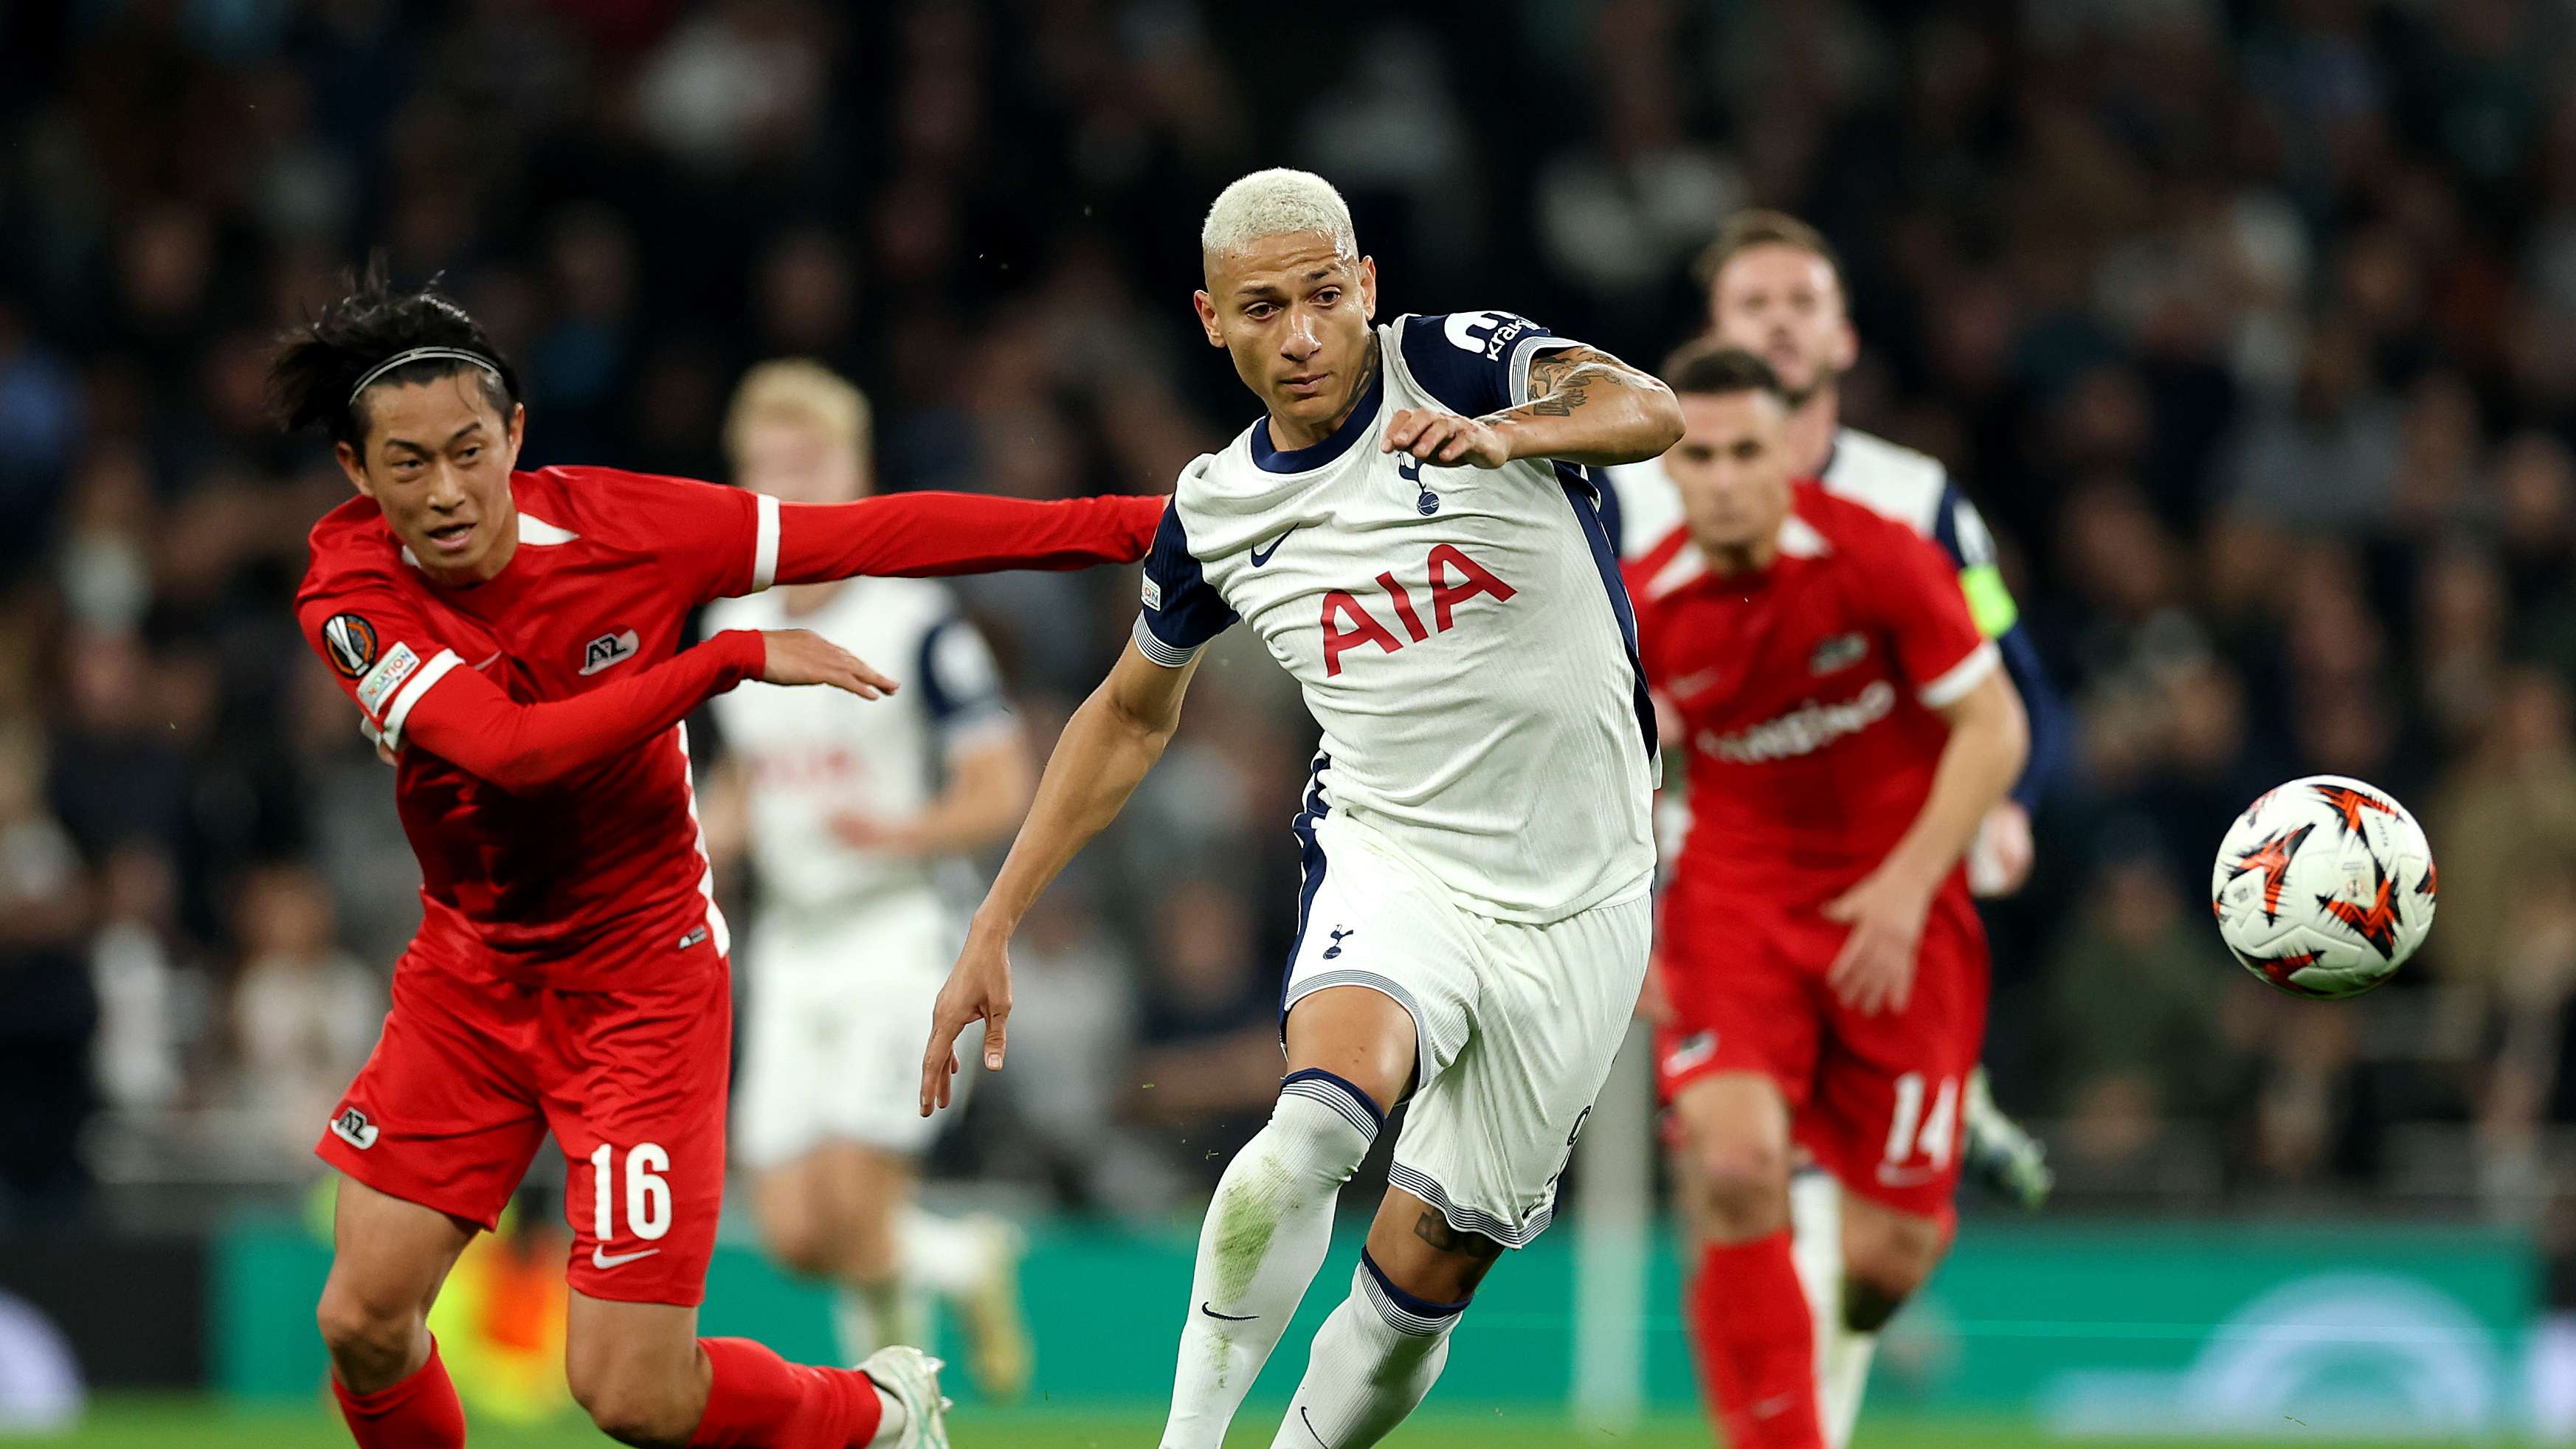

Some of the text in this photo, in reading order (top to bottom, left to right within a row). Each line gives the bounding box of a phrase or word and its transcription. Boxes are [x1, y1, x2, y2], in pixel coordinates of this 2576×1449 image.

[588, 636, 628, 668] AZ
[1320, 543, 1518, 678] AIA
[1885, 1071, 1959, 1173] 14
[591, 1142, 672, 1241] 16
